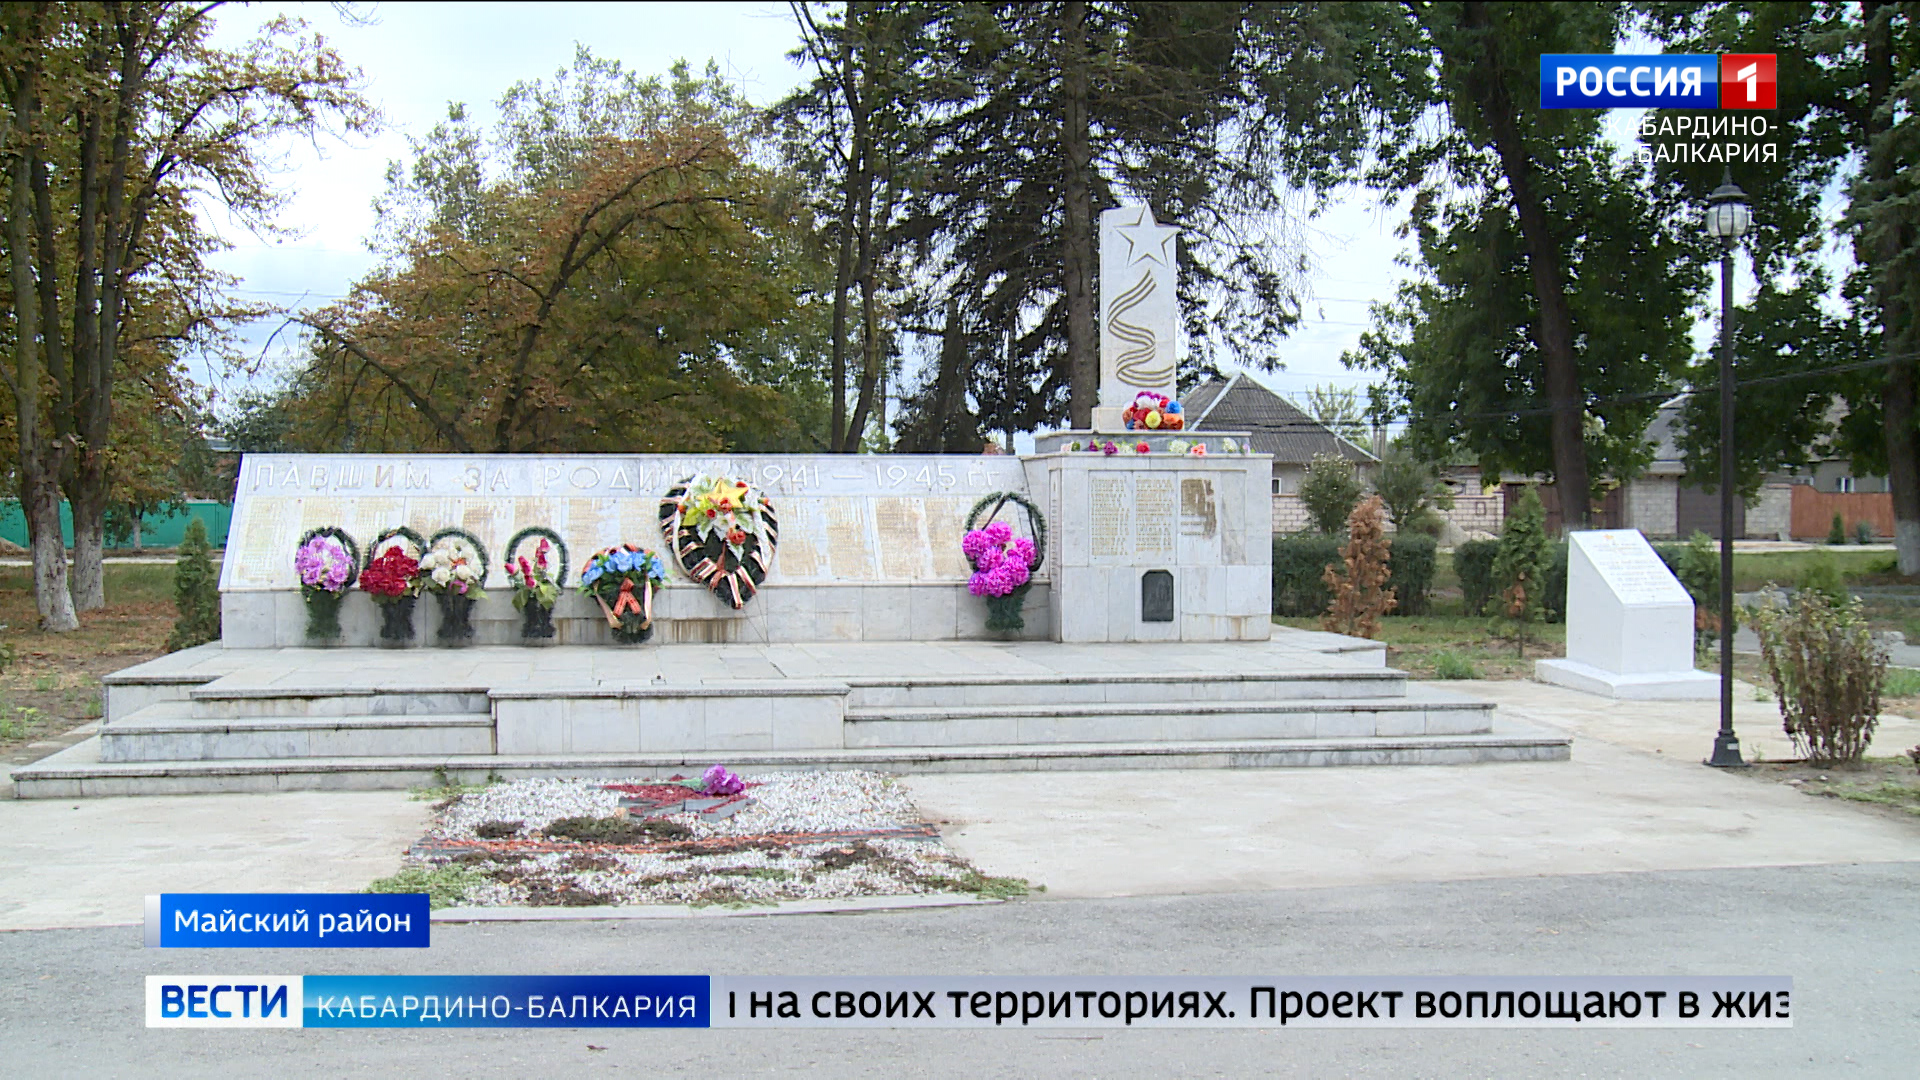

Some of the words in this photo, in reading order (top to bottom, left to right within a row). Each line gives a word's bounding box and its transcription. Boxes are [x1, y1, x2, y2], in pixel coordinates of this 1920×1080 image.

[253, 464, 431, 489] ПАВШИМ
[463, 465, 510, 490] ЗА
[543, 464, 700, 490] РОДИН
[874, 464, 957, 488] 1945
